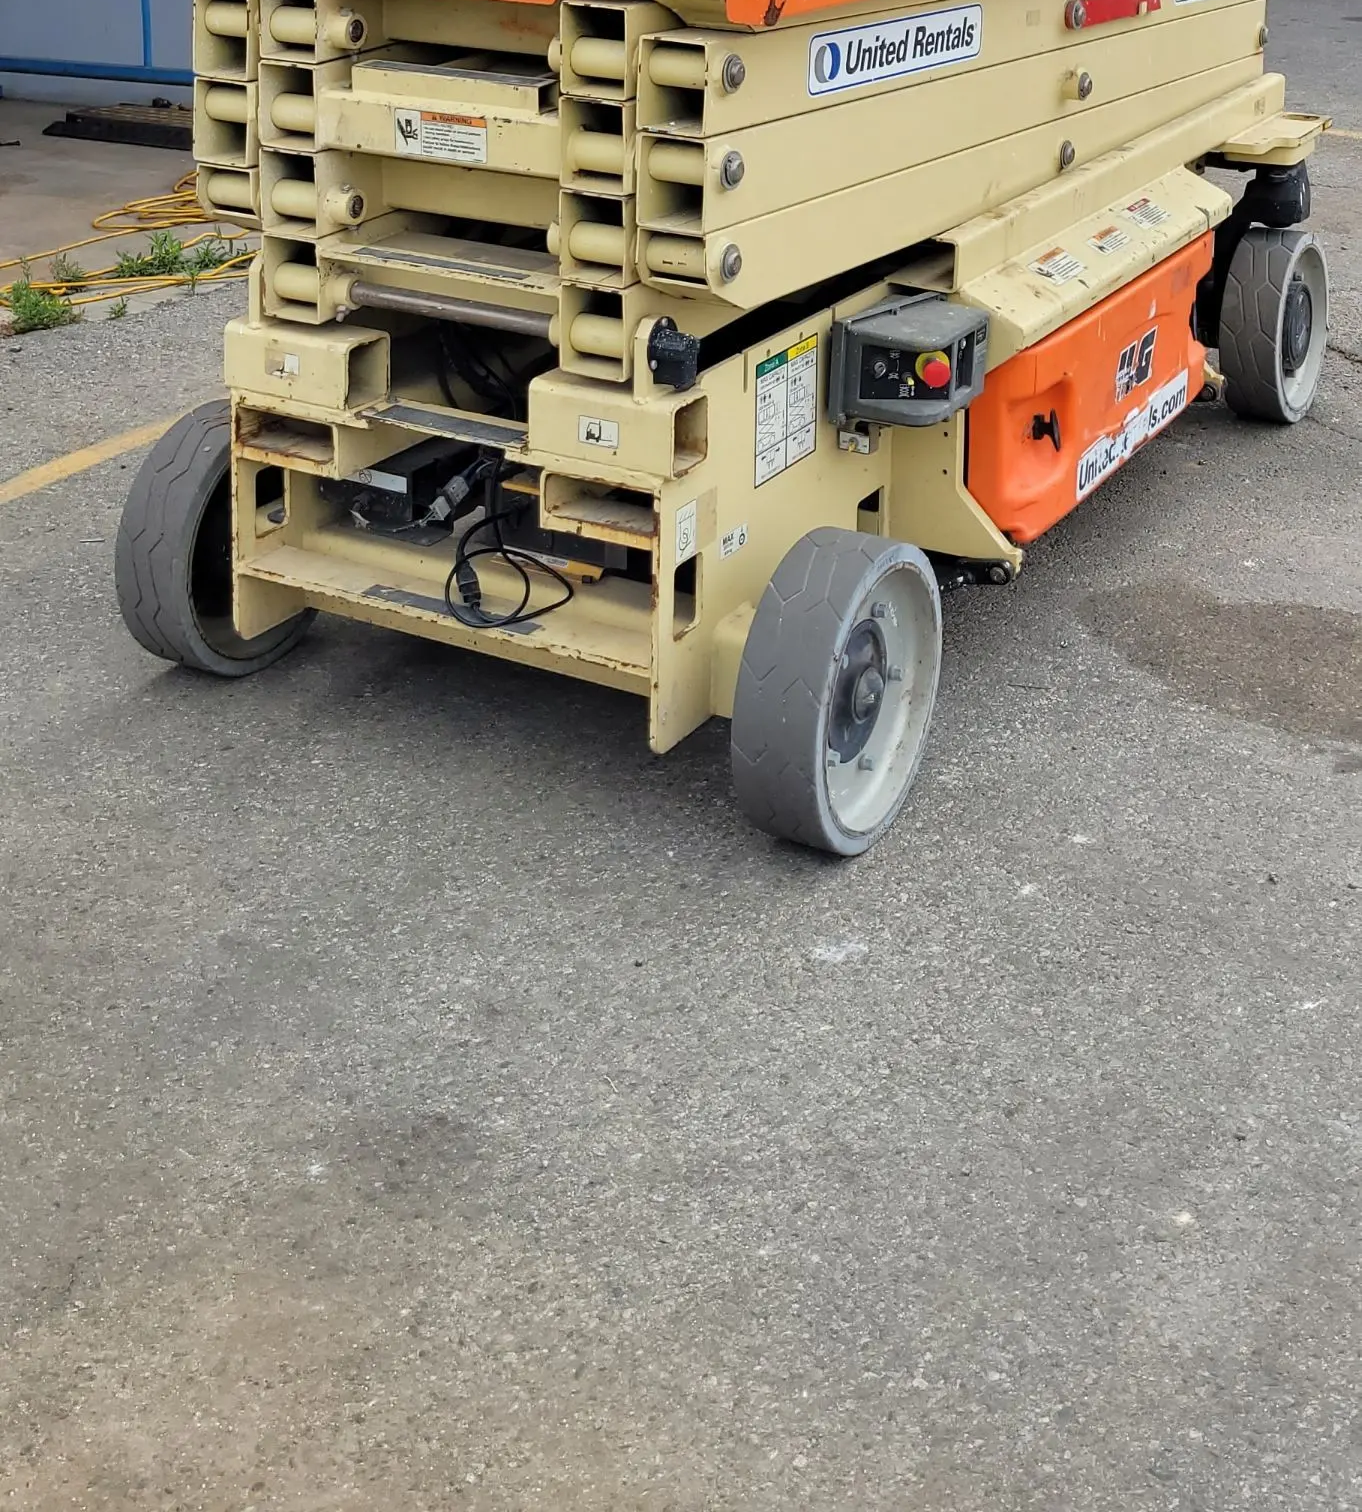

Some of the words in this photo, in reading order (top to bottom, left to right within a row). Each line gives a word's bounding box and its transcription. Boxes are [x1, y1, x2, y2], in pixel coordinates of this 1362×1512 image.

[845, 29, 910, 75] United
[912, 16, 975, 59] Rentals
[722, 533, 734, 546] MAX
